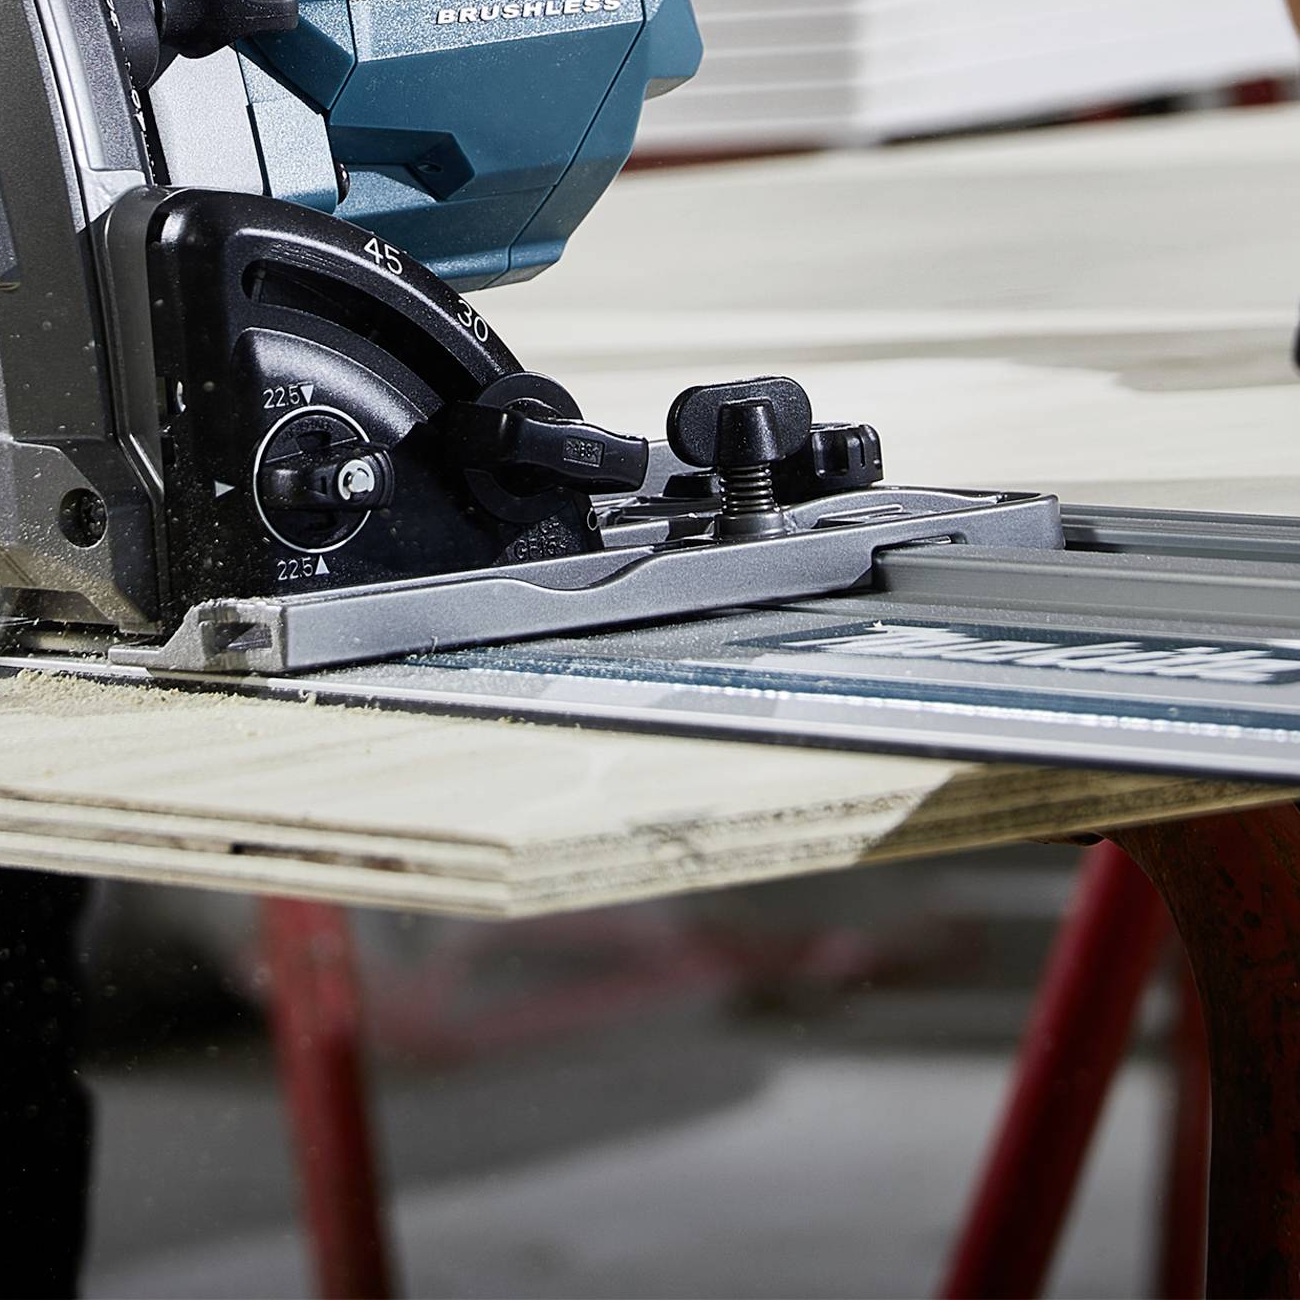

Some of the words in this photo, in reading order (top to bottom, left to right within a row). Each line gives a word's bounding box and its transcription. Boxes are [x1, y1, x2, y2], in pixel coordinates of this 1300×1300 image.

[363, 236, 404, 275] 45
[456, 299, 489, 343] 30
[262, 385, 300, 410] 22.5
[277, 557, 313, 582] 22.5
